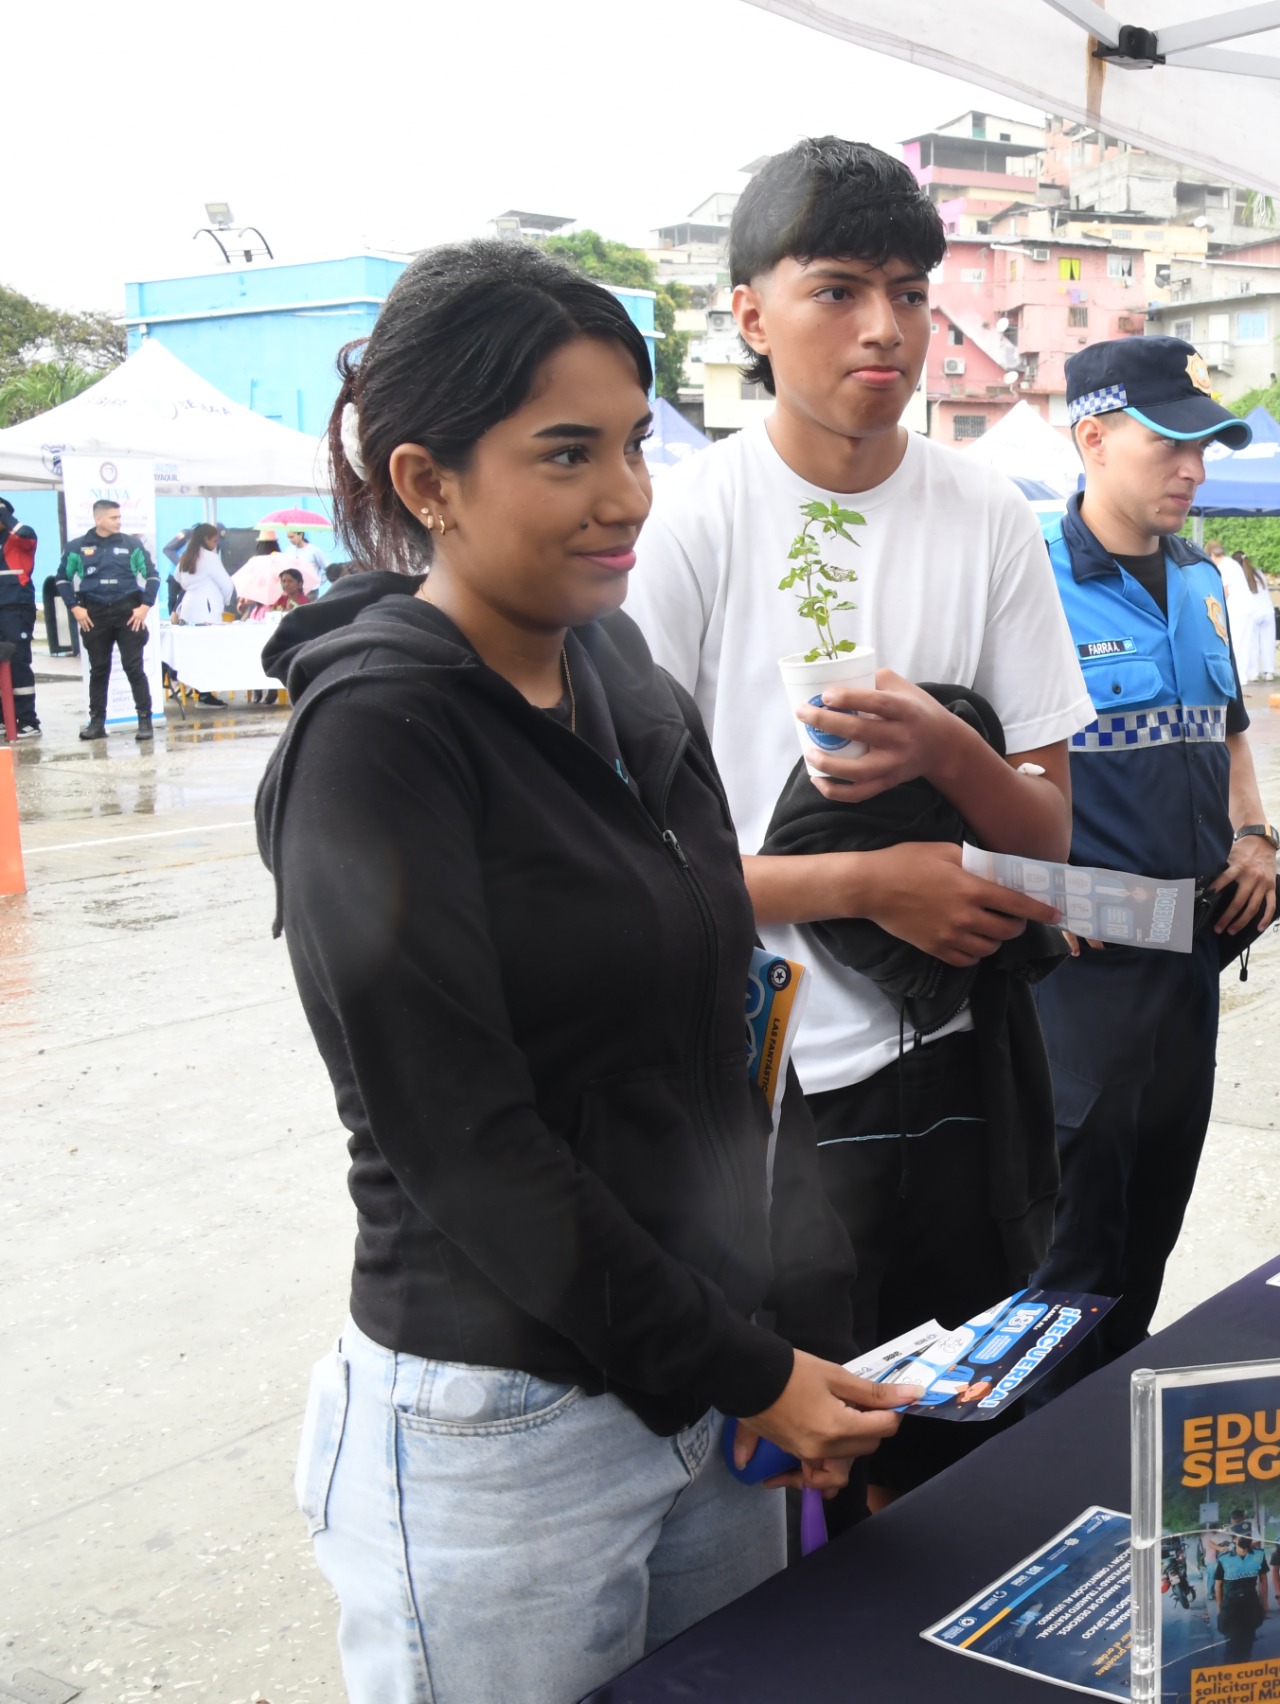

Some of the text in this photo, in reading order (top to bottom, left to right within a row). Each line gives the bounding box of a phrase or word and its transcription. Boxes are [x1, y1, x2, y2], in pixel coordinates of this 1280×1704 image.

[762, 1018, 780, 1095] LAS FANTÁSTIC
[1000, 1308, 1044, 1333] 181
[977, 1307, 1082, 1408] ¡RECUERDA!
[1070, 1566, 1110, 1599] ORIENTACIÓN
[1095, 1583, 1121, 1604] MANEJO
[1087, 1602, 1099, 1611] DE
[1104, 1607, 1119, 1618] DEL
[1081, 1616, 1109, 1639] ESPACIO
[1195, 1671, 1232, 1685] Ante
[1195, 1680, 1257, 1697] solicitar
